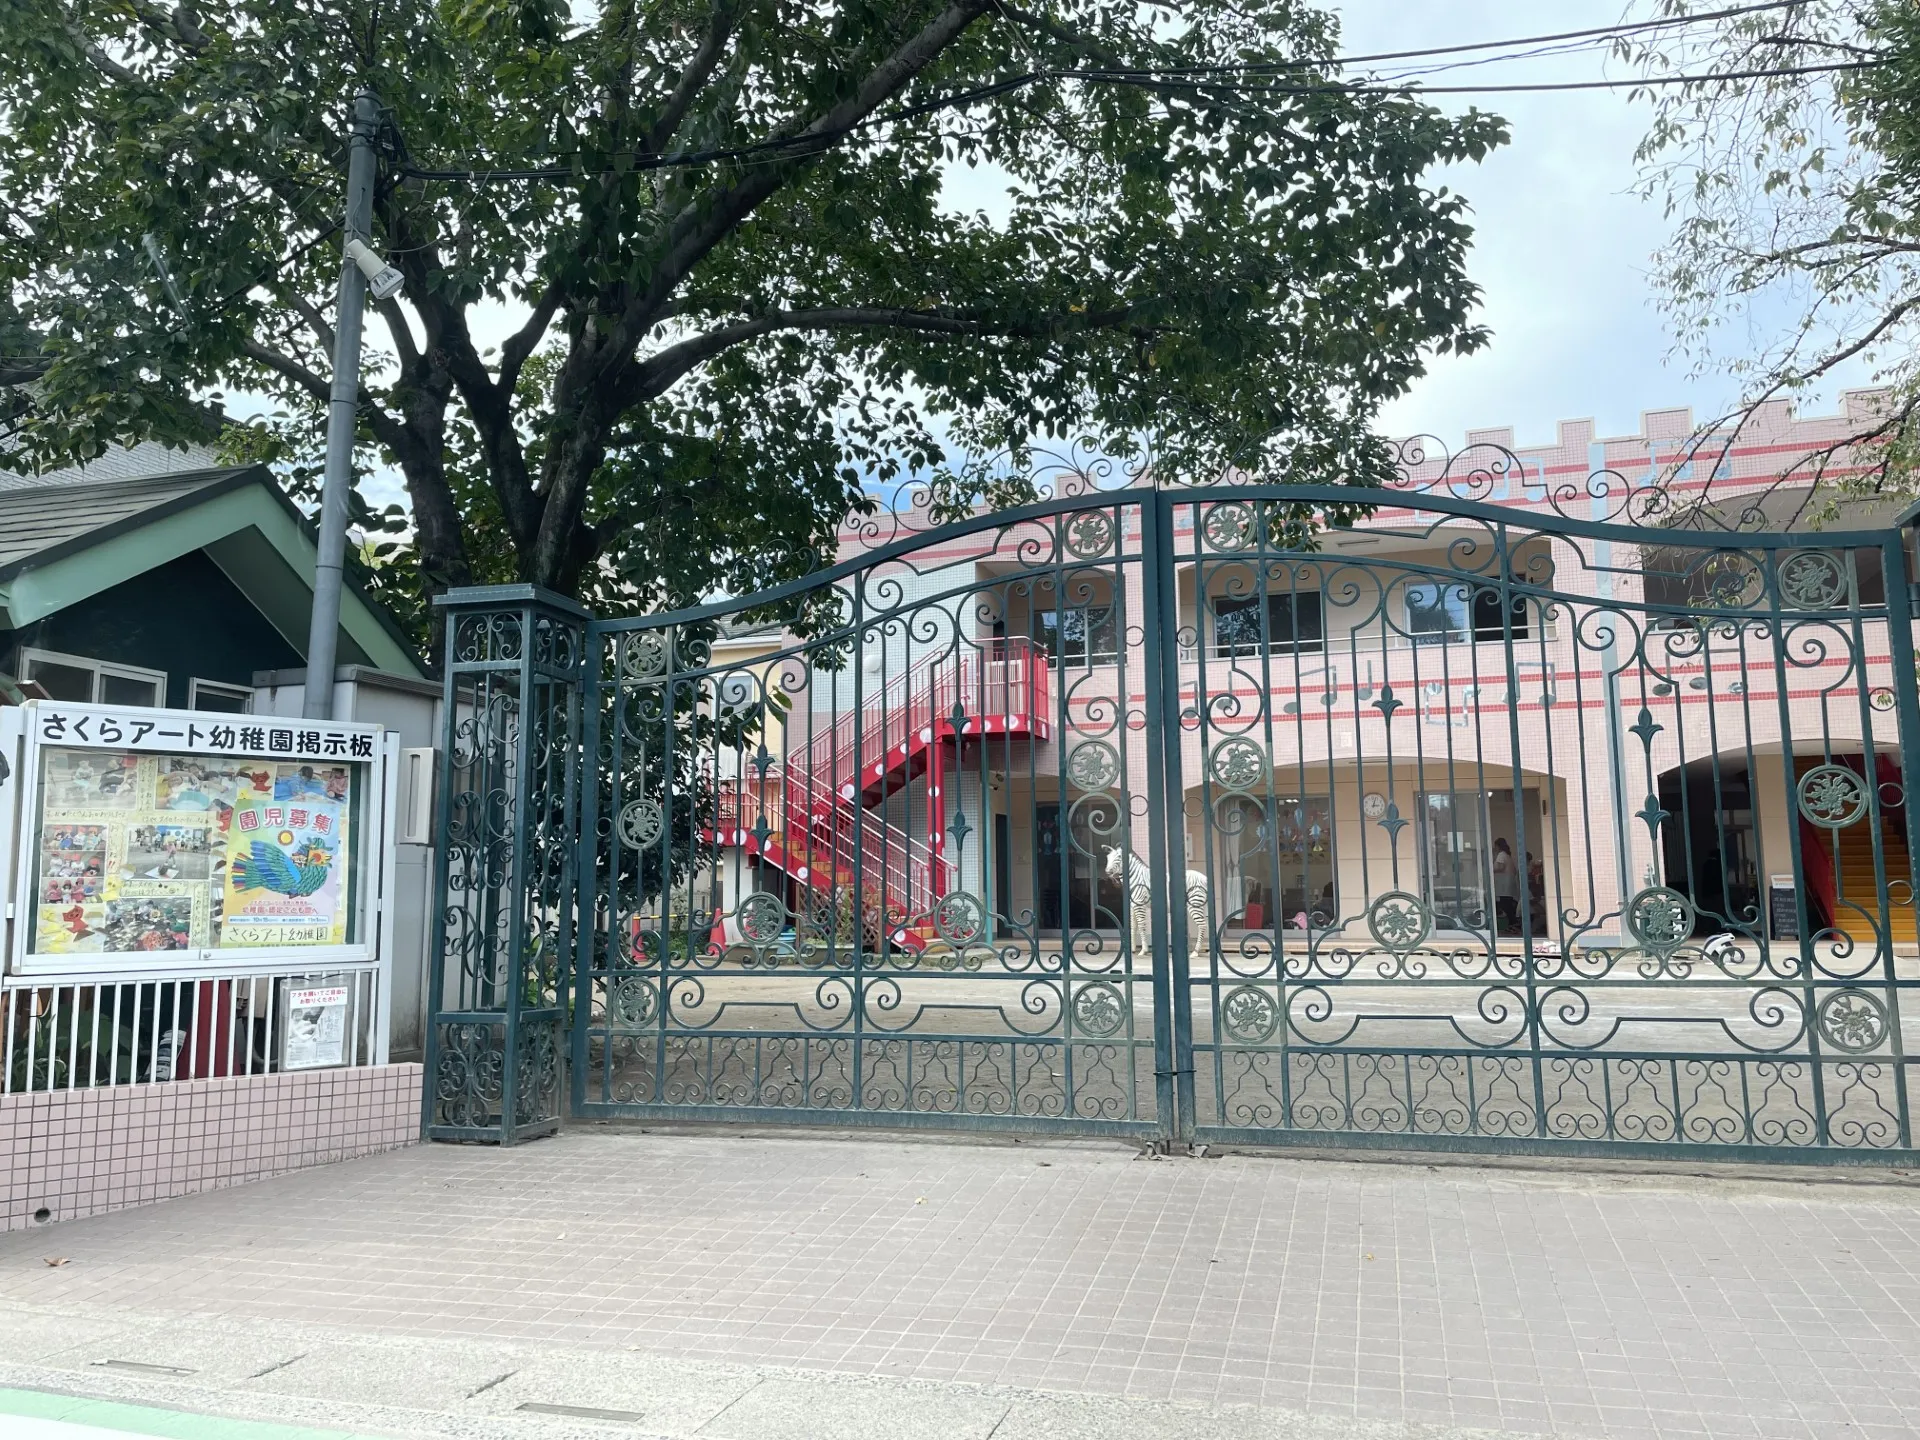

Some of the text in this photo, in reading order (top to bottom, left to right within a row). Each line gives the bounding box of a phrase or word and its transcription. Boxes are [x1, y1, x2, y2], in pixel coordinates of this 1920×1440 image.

[43, 713, 373, 757] さくらアート幼稚園掲示板
[239, 808, 332, 835] 園児募集
[229, 926, 328, 942] さくらアート幼稚園
